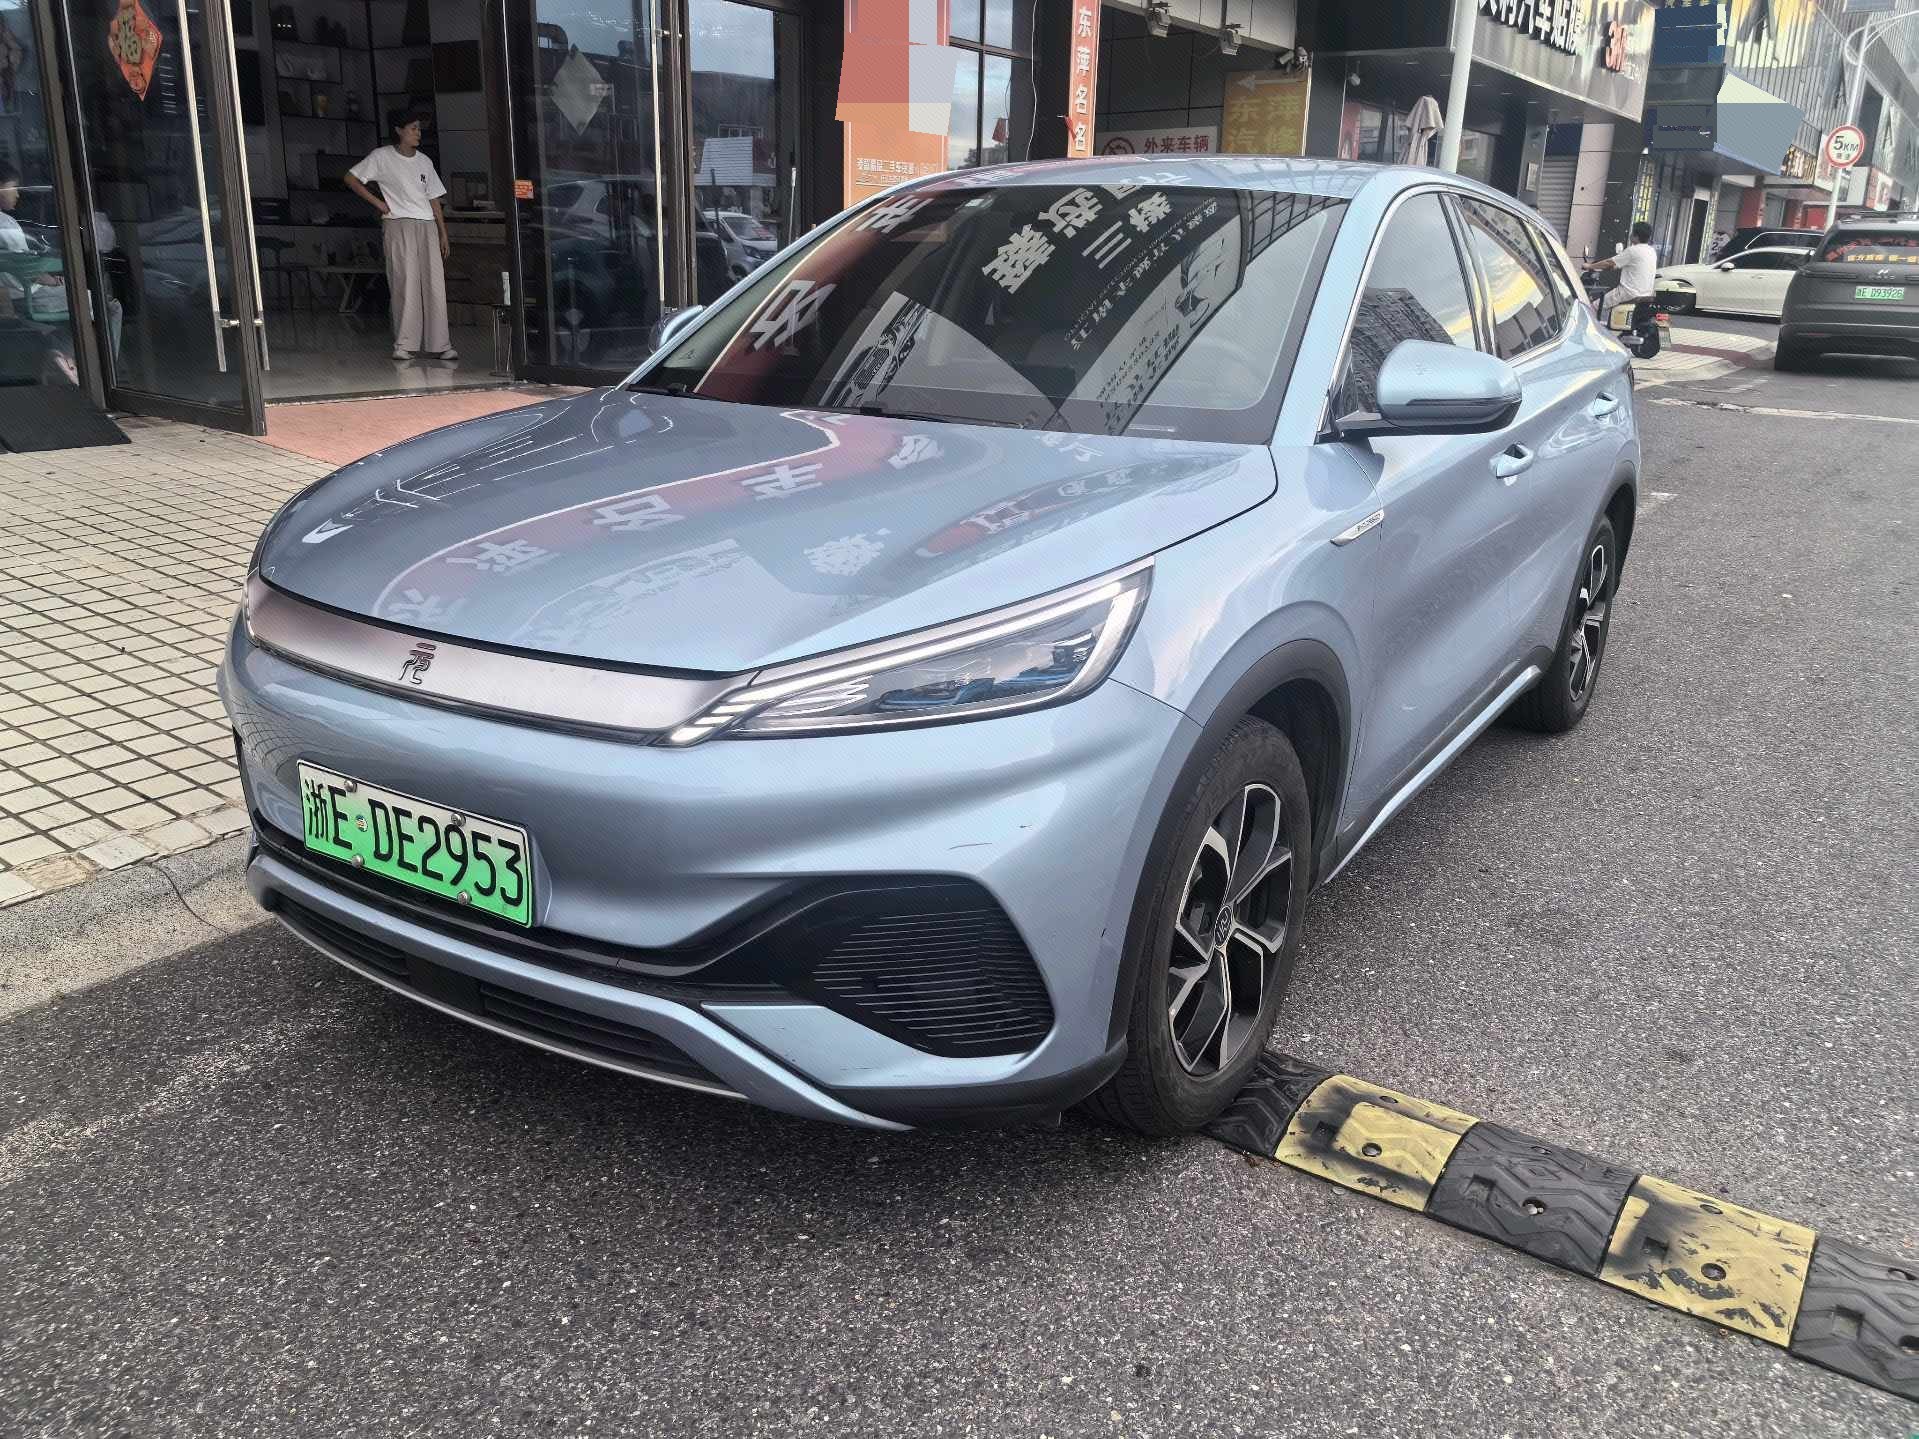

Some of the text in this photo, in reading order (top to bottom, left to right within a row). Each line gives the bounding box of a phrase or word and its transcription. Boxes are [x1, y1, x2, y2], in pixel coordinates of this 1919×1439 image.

[1143, 135, 1210, 154] 外来车辆
[367, 797, 524, 907] DE2953
